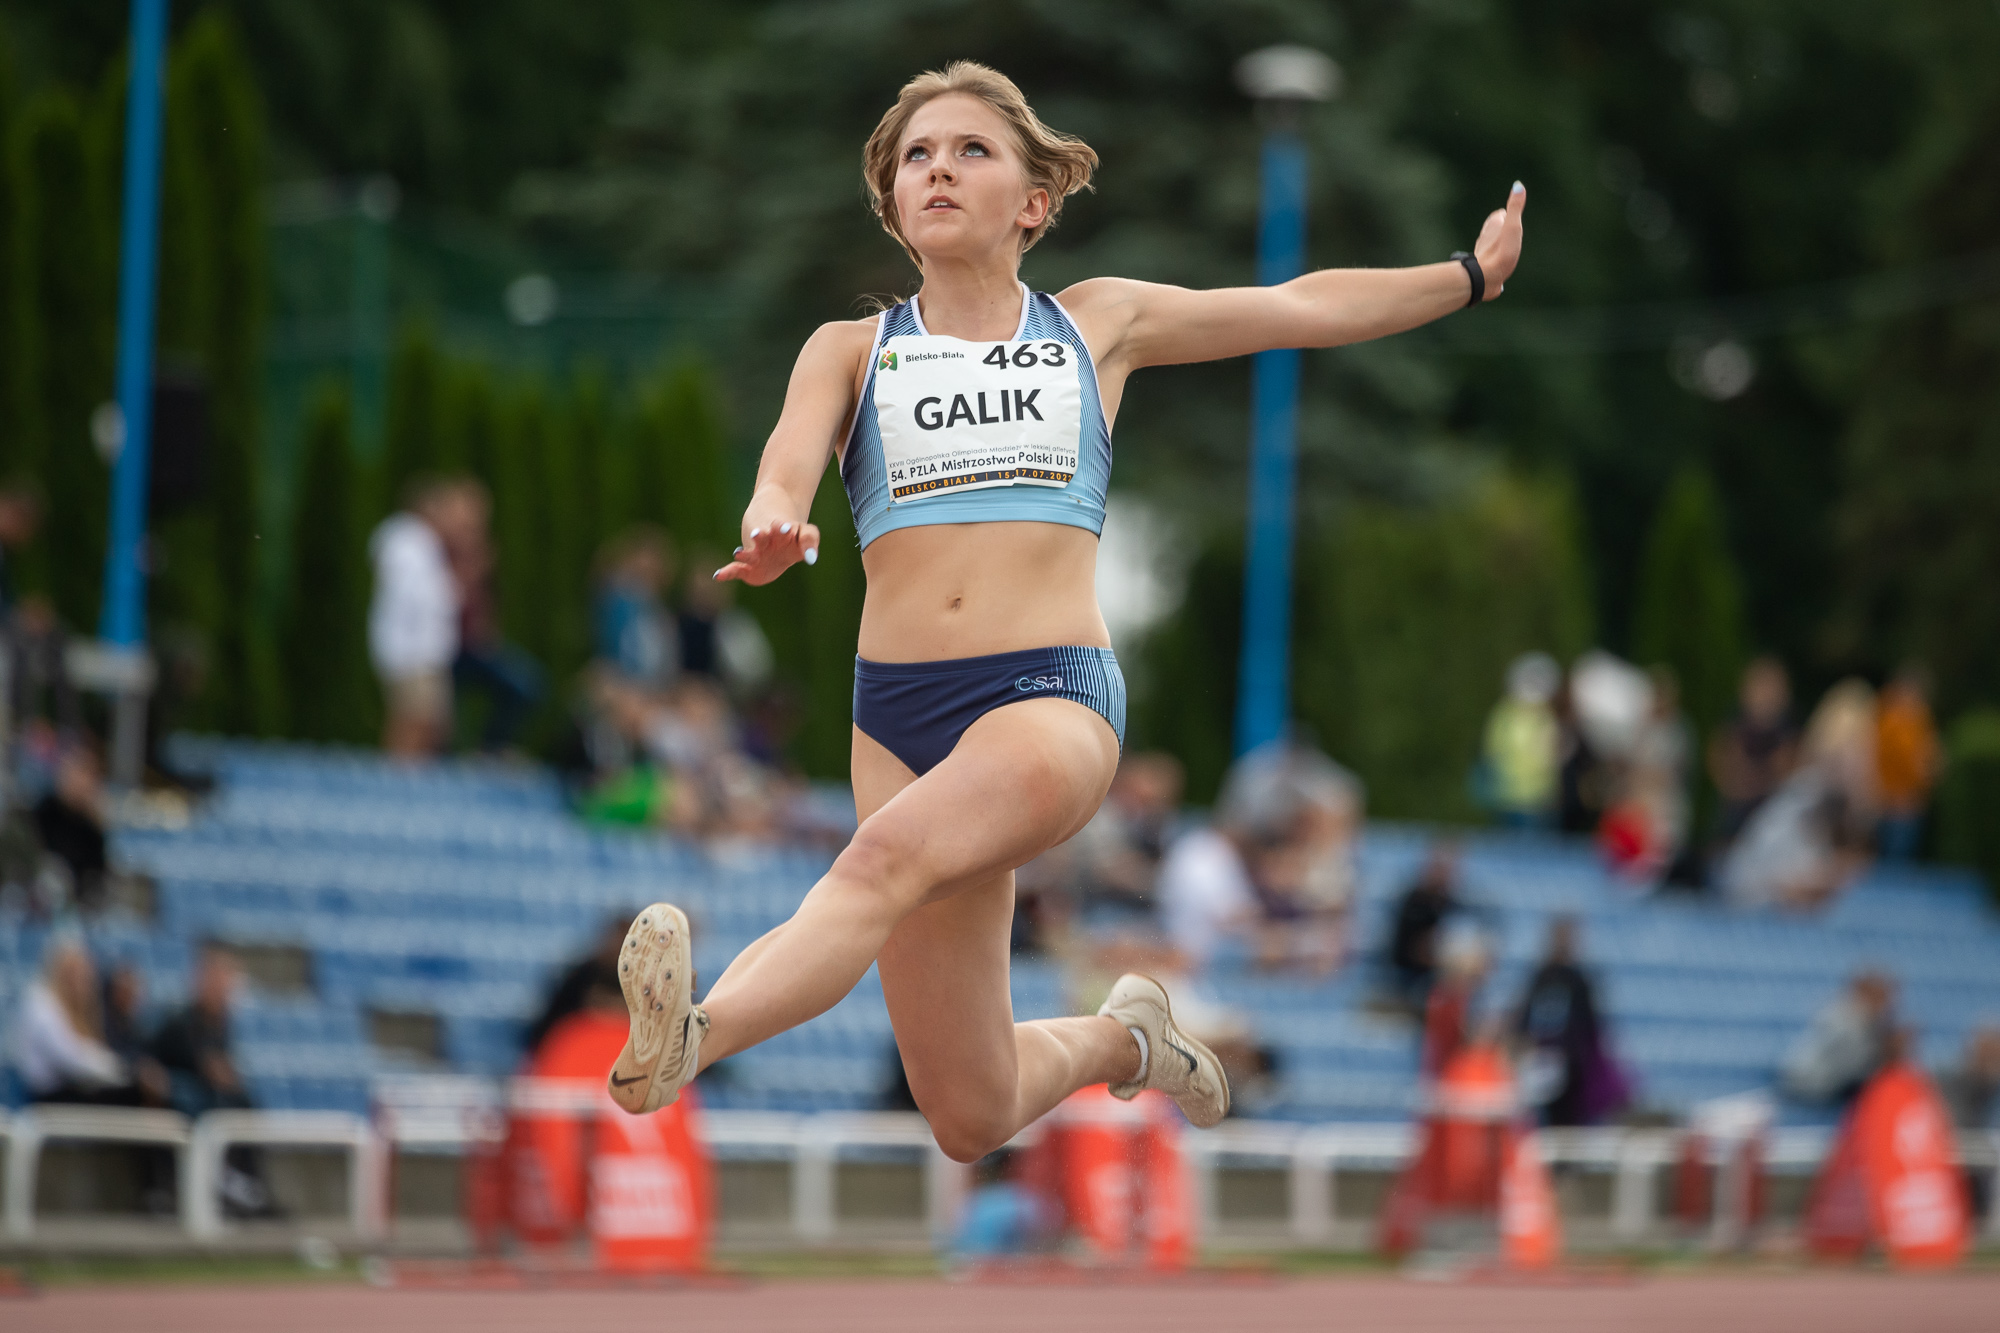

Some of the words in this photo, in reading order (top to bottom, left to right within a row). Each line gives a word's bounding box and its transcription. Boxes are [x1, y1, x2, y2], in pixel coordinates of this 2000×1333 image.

[982, 343, 1067, 369] 463
[914, 388, 1044, 431] GALIK
[891, 469, 907, 482] 54.
[910, 463, 938, 478] PZLA
[941, 455, 1015, 472] Mistrzostwa
[1018, 451, 1053, 465] Polski
[1056, 454, 1076, 468] U18
[906, 452, 950, 465] Ogólnopolska
[952, 447, 987, 457] Olimpiada
[1031, 443, 1051, 452] lekkiej
[1052, 446, 1076, 455] atletyce
[895, 474, 977, 497] BIELSKO-BIAŁA
